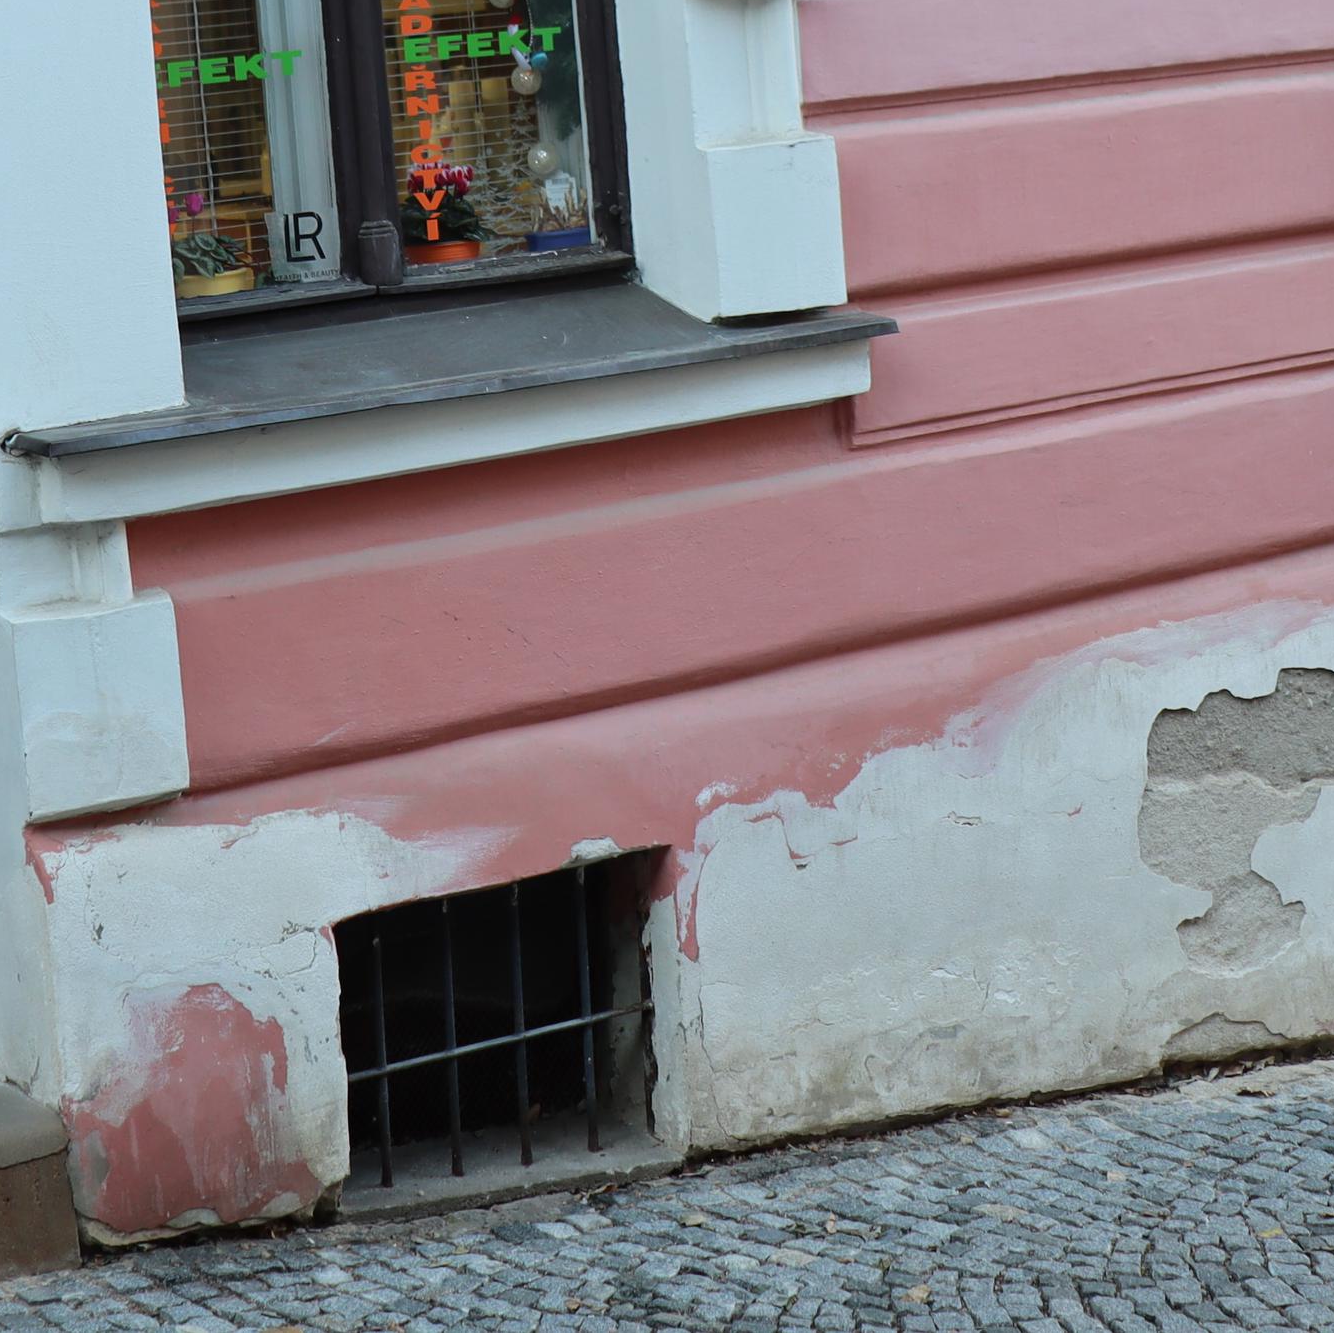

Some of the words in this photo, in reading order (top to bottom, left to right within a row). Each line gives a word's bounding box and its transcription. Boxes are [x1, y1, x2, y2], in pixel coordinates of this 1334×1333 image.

[403, 27, 561, 63] EFEKT
[155, 50, 302, 90] FEKT
[283, 212, 326, 262] LR
